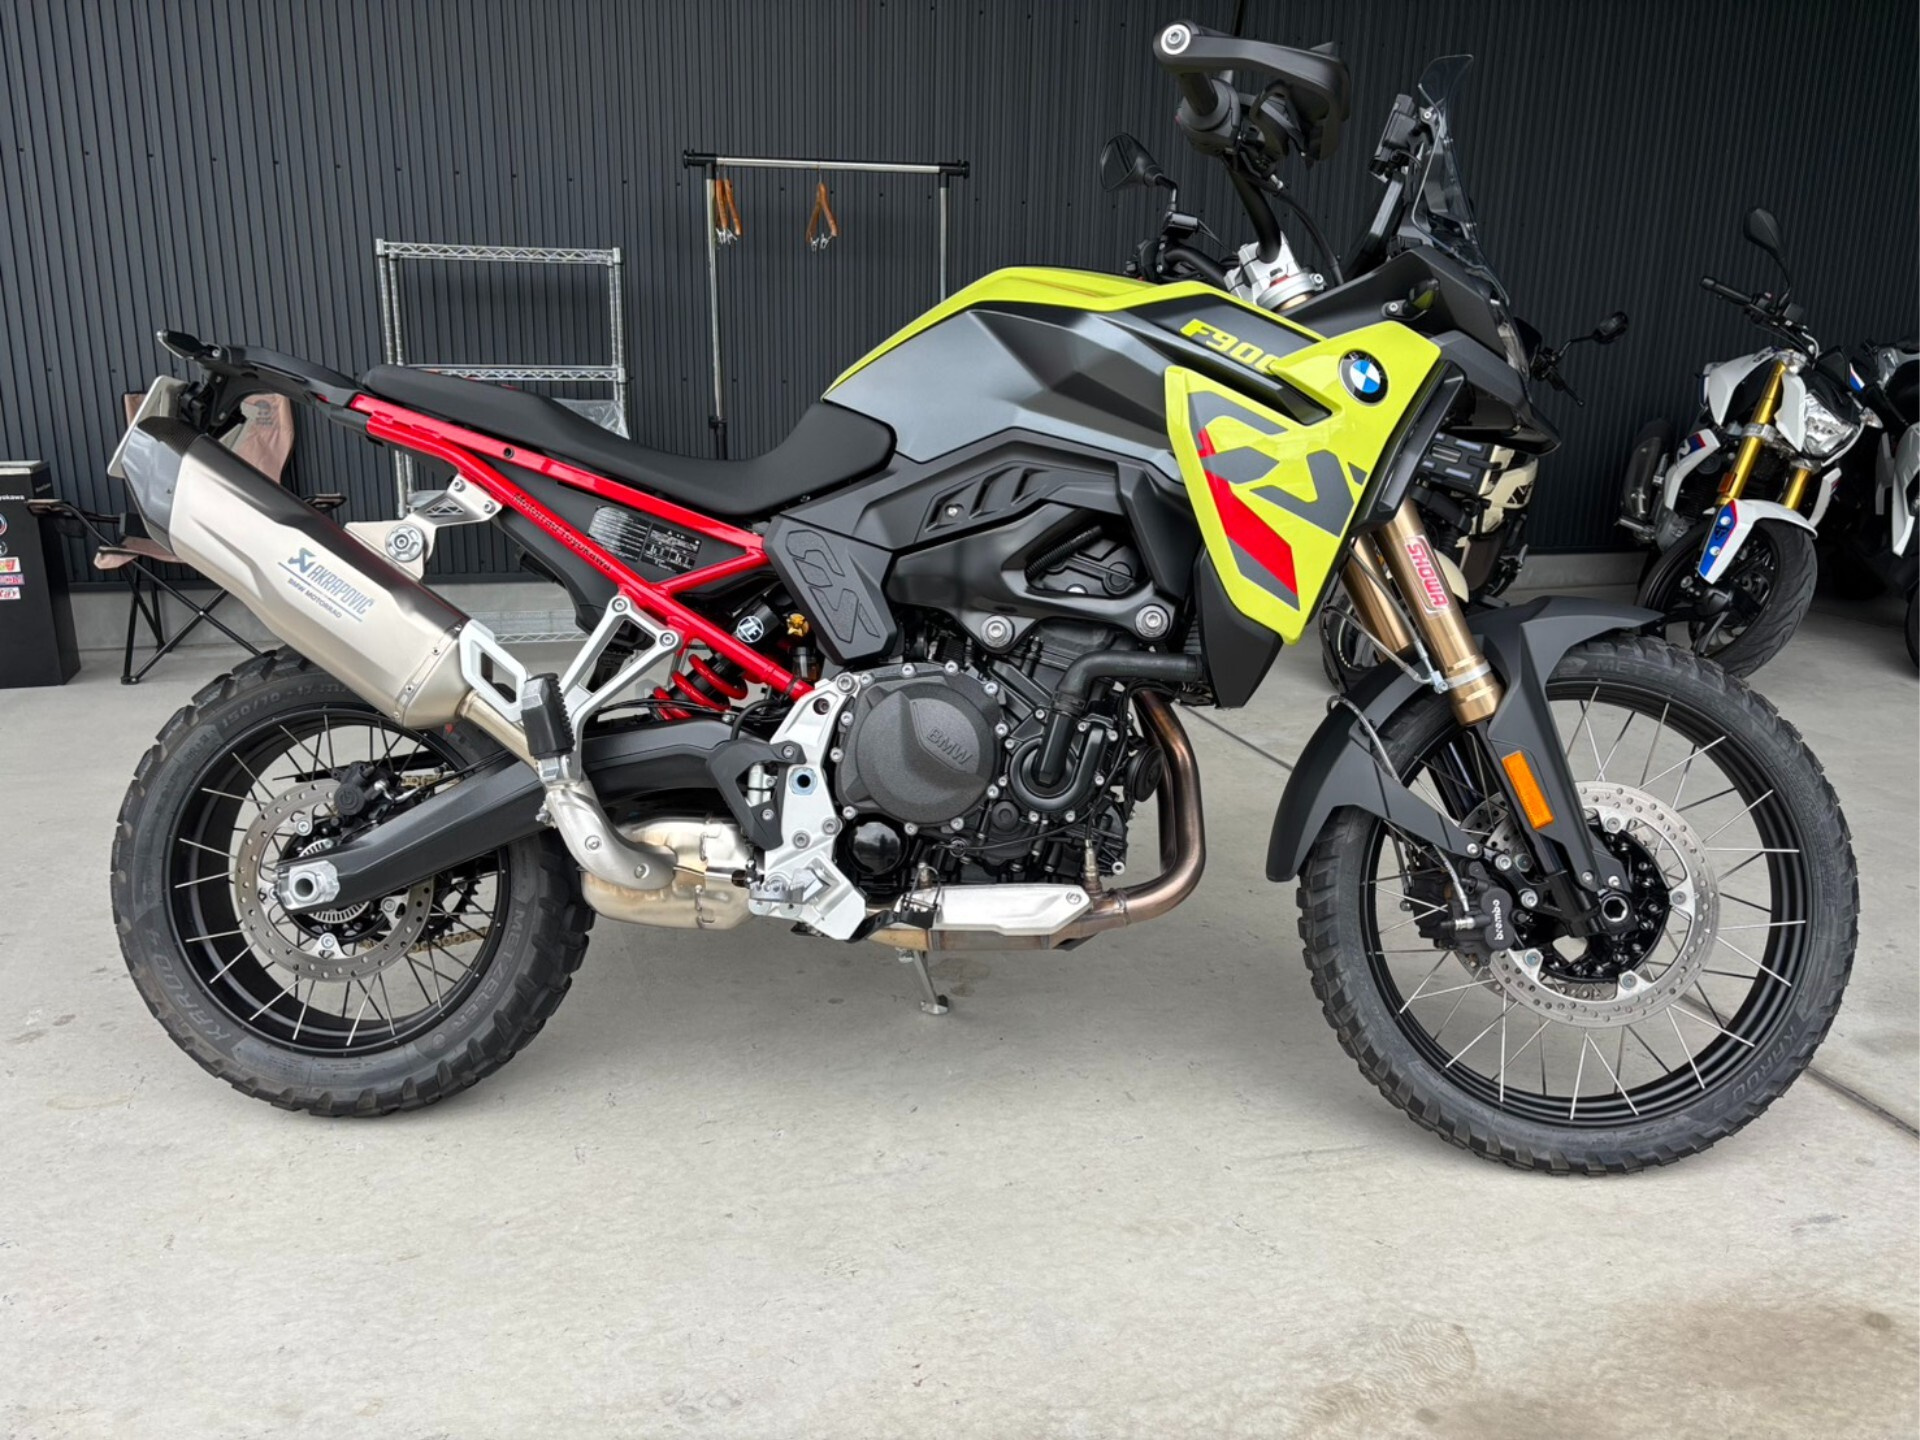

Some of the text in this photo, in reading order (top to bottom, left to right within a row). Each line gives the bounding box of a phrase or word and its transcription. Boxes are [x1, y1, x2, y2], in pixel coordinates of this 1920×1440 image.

[1406, 543, 1449, 607] SHOWA
[927, 727, 973, 765] BMW
[1492, 899, 1504, 941] brembo
[151, 948, 232, 1046] KAROO
[449, 907, 528, 1035] METZELER
